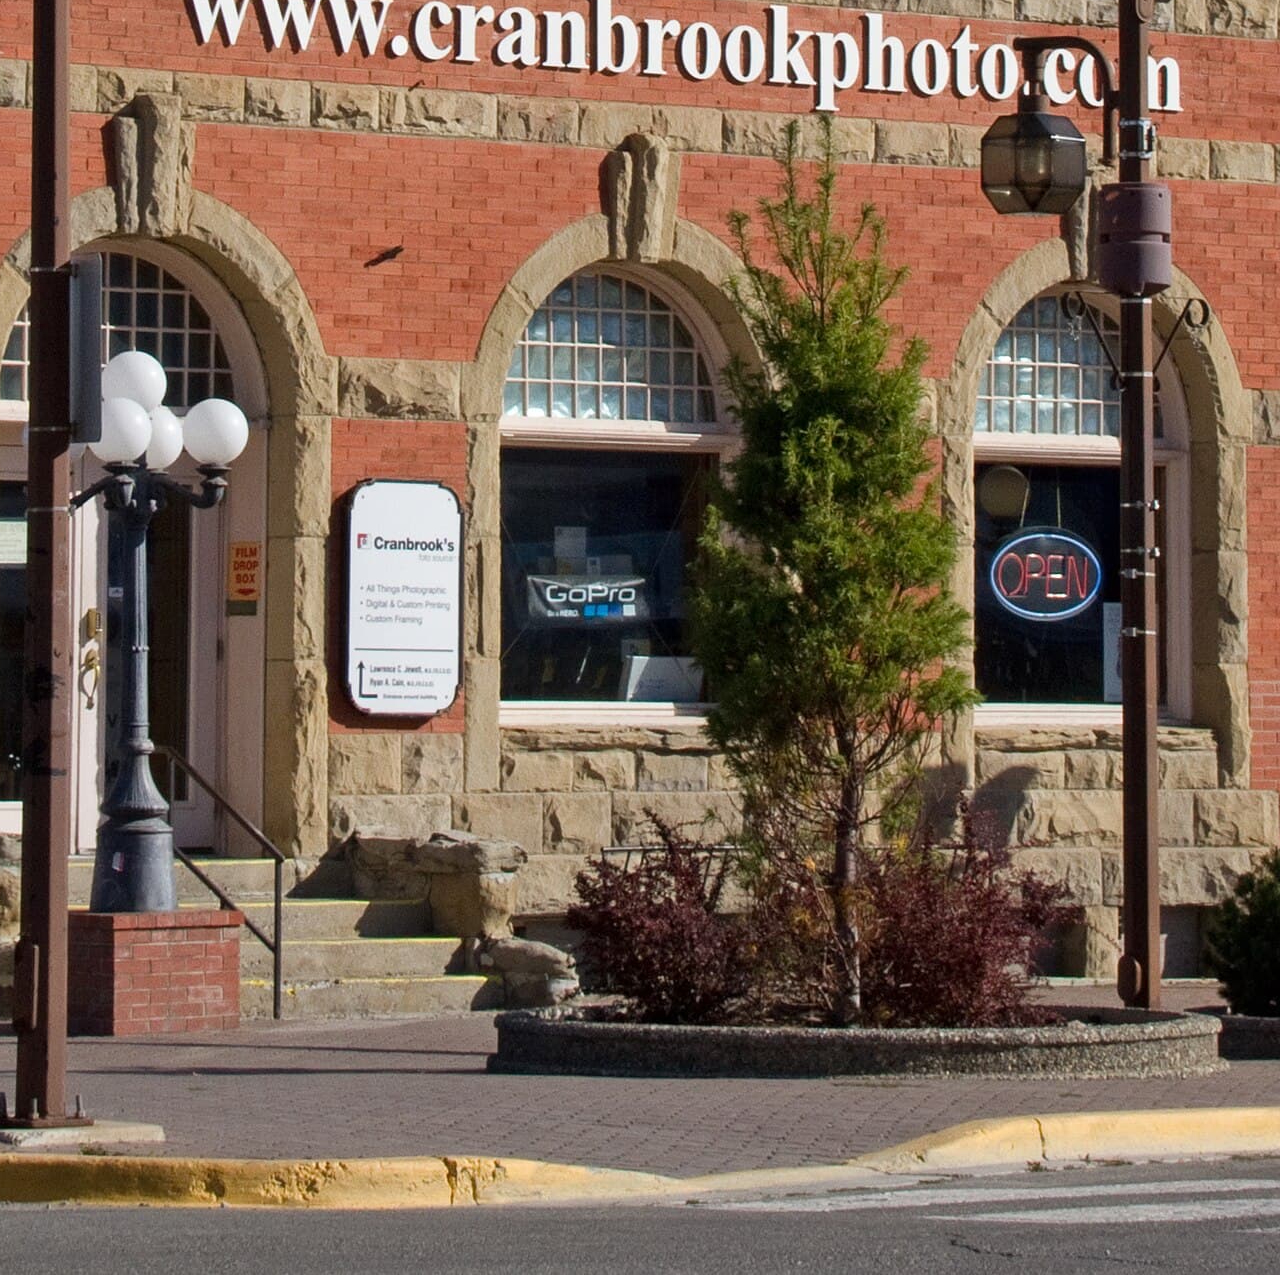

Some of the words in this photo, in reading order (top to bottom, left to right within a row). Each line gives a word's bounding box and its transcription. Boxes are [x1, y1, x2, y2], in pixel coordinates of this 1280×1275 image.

[374, 536, 455, 552] Cranbrook's
[235, 547, 258, 557] FILM
[233, 560, 260, 571] DROP
[235, 574, 255, 584] BOX
[998, 553, 1089, 599] OPEN
[546, 585, 636, 602] GoPro
